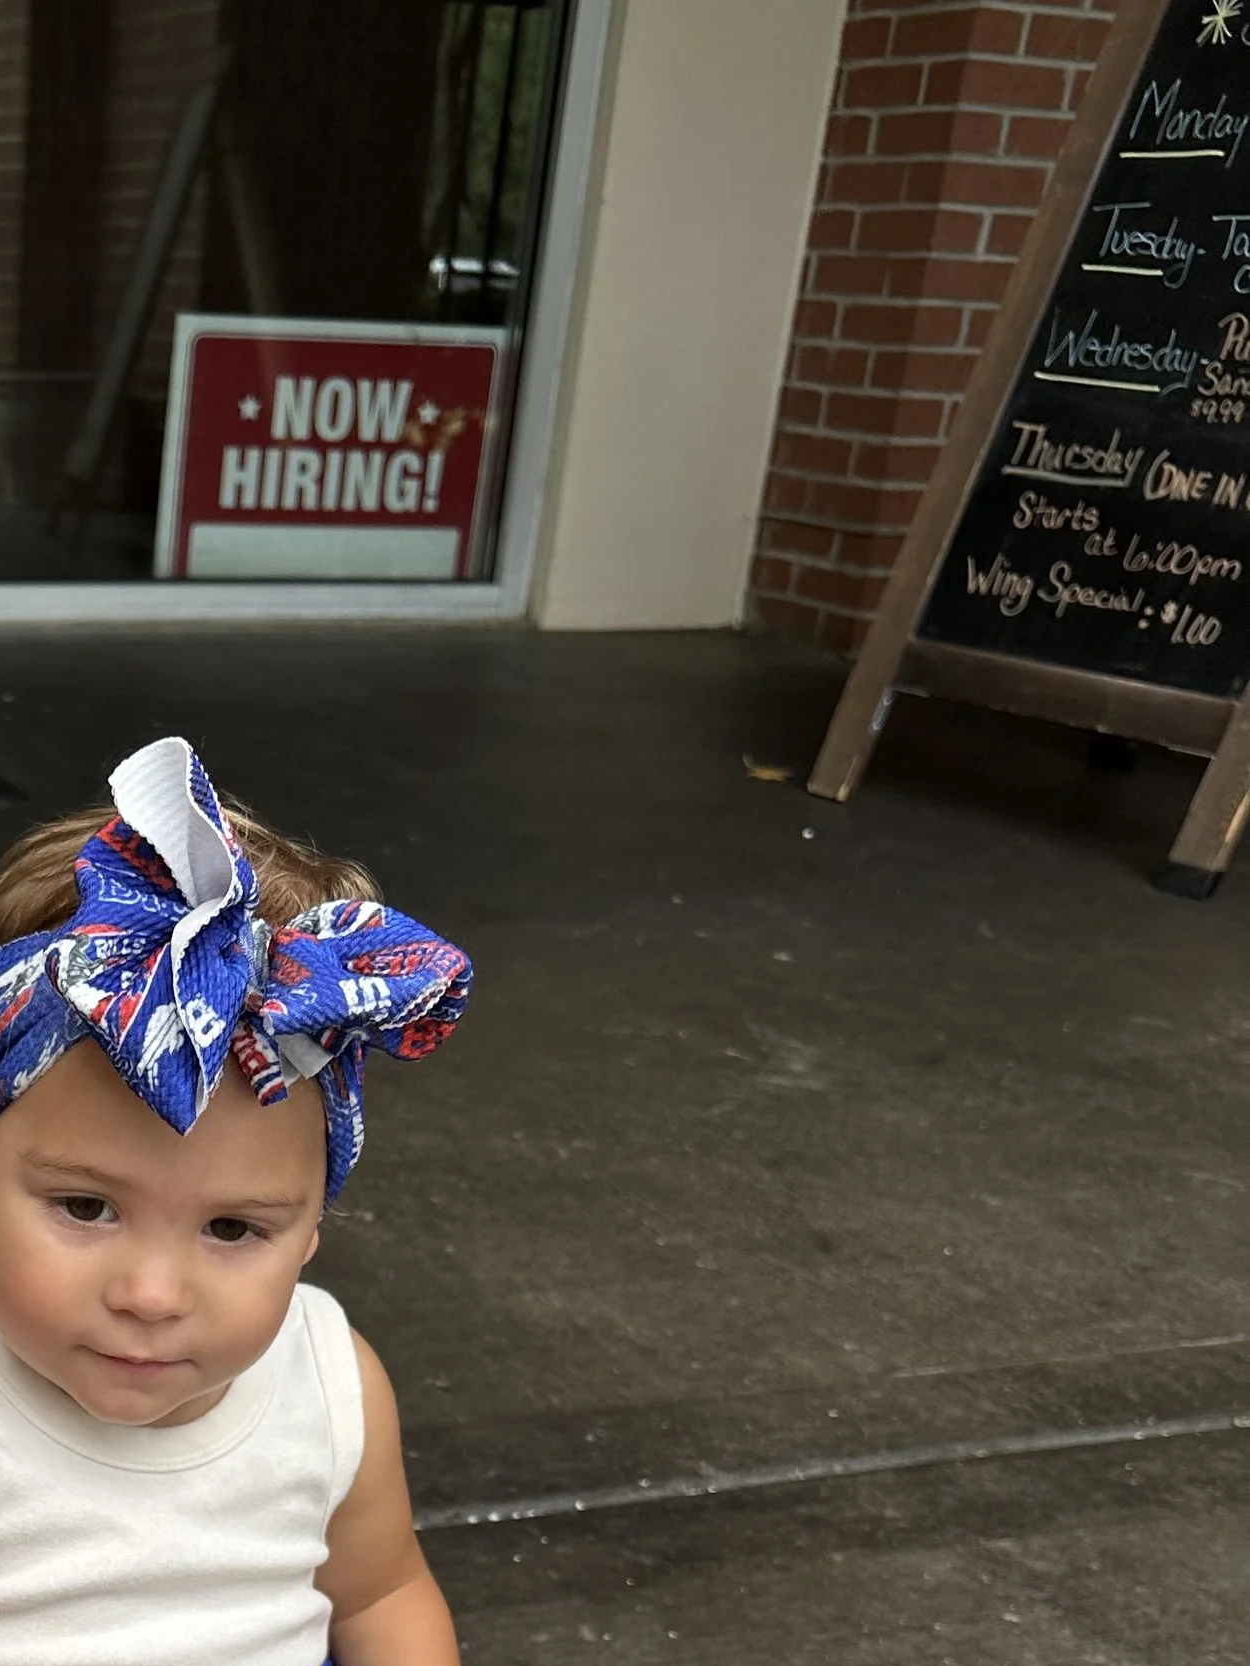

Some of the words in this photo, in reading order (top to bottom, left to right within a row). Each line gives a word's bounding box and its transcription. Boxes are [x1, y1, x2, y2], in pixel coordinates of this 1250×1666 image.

[1128, 77, 1249, 169] Monday
[270, 375, 414, 443] NOW
[217, 444, 446, 515] HIRING!
[1012, 420, 1145, 487] Thursday
[1211, 472, 1247, 510] IN
[1012, 489, 1101, 532] Starts
[966, 550, 1035, 618] Wing
[1083, 527, 1119, 557] at
[1122, 532, 1242, 586] 6:00pm
